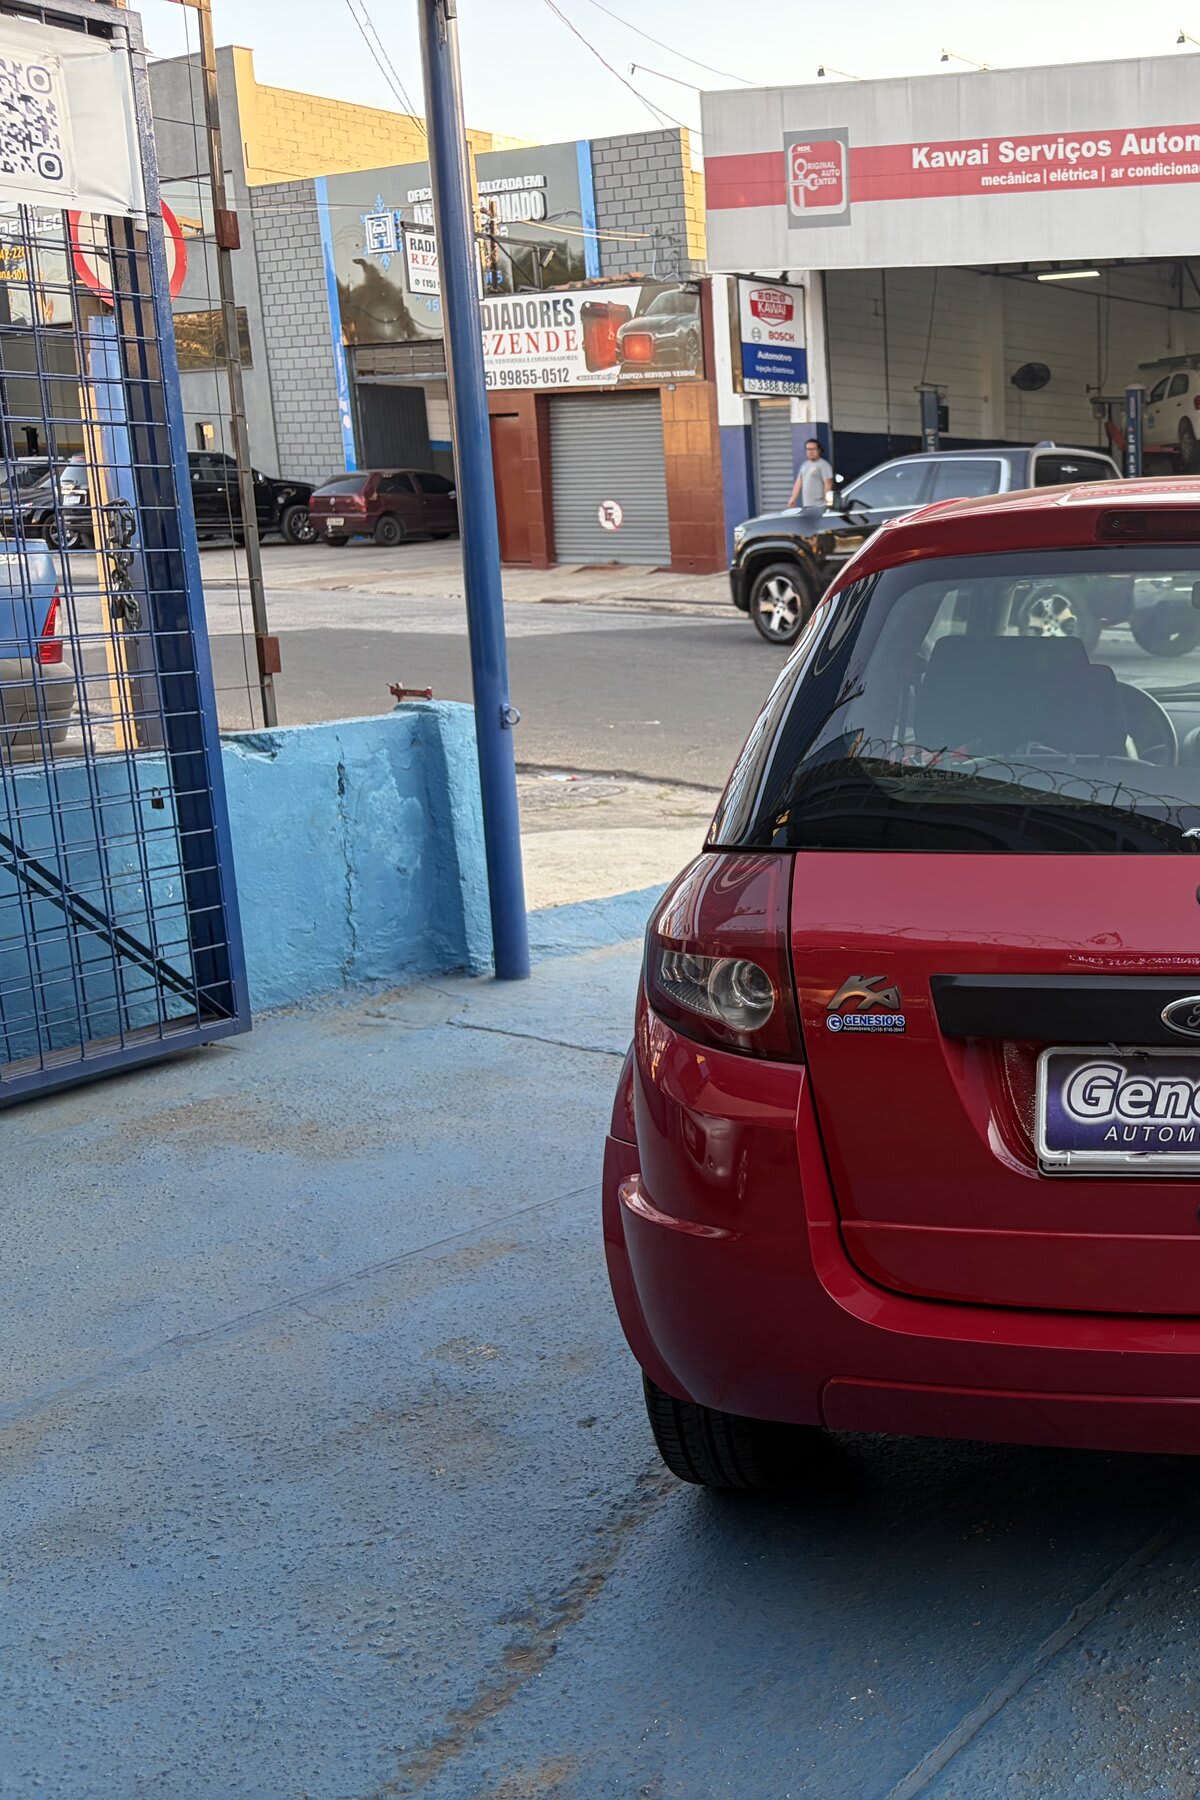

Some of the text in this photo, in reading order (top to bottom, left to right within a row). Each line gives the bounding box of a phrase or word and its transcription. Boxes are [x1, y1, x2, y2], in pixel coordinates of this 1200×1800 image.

[912, 143, 989, 169] Kawai
[998, 138, 1112, 164] Serviços
[981, 172, 1041, 186] mecânica
[1049, 168, 1099, 182] elétrica
[1110, 167, 1124, 179] ar
[481, 298, 576, 332] DIADORES
[757, 301, 787, 315] KAWAI
[482, 328, 579, 356] EZENDE
[768, 330, 796, 342] BOSCH
[500, 367, 570, 386] 99855-0512
